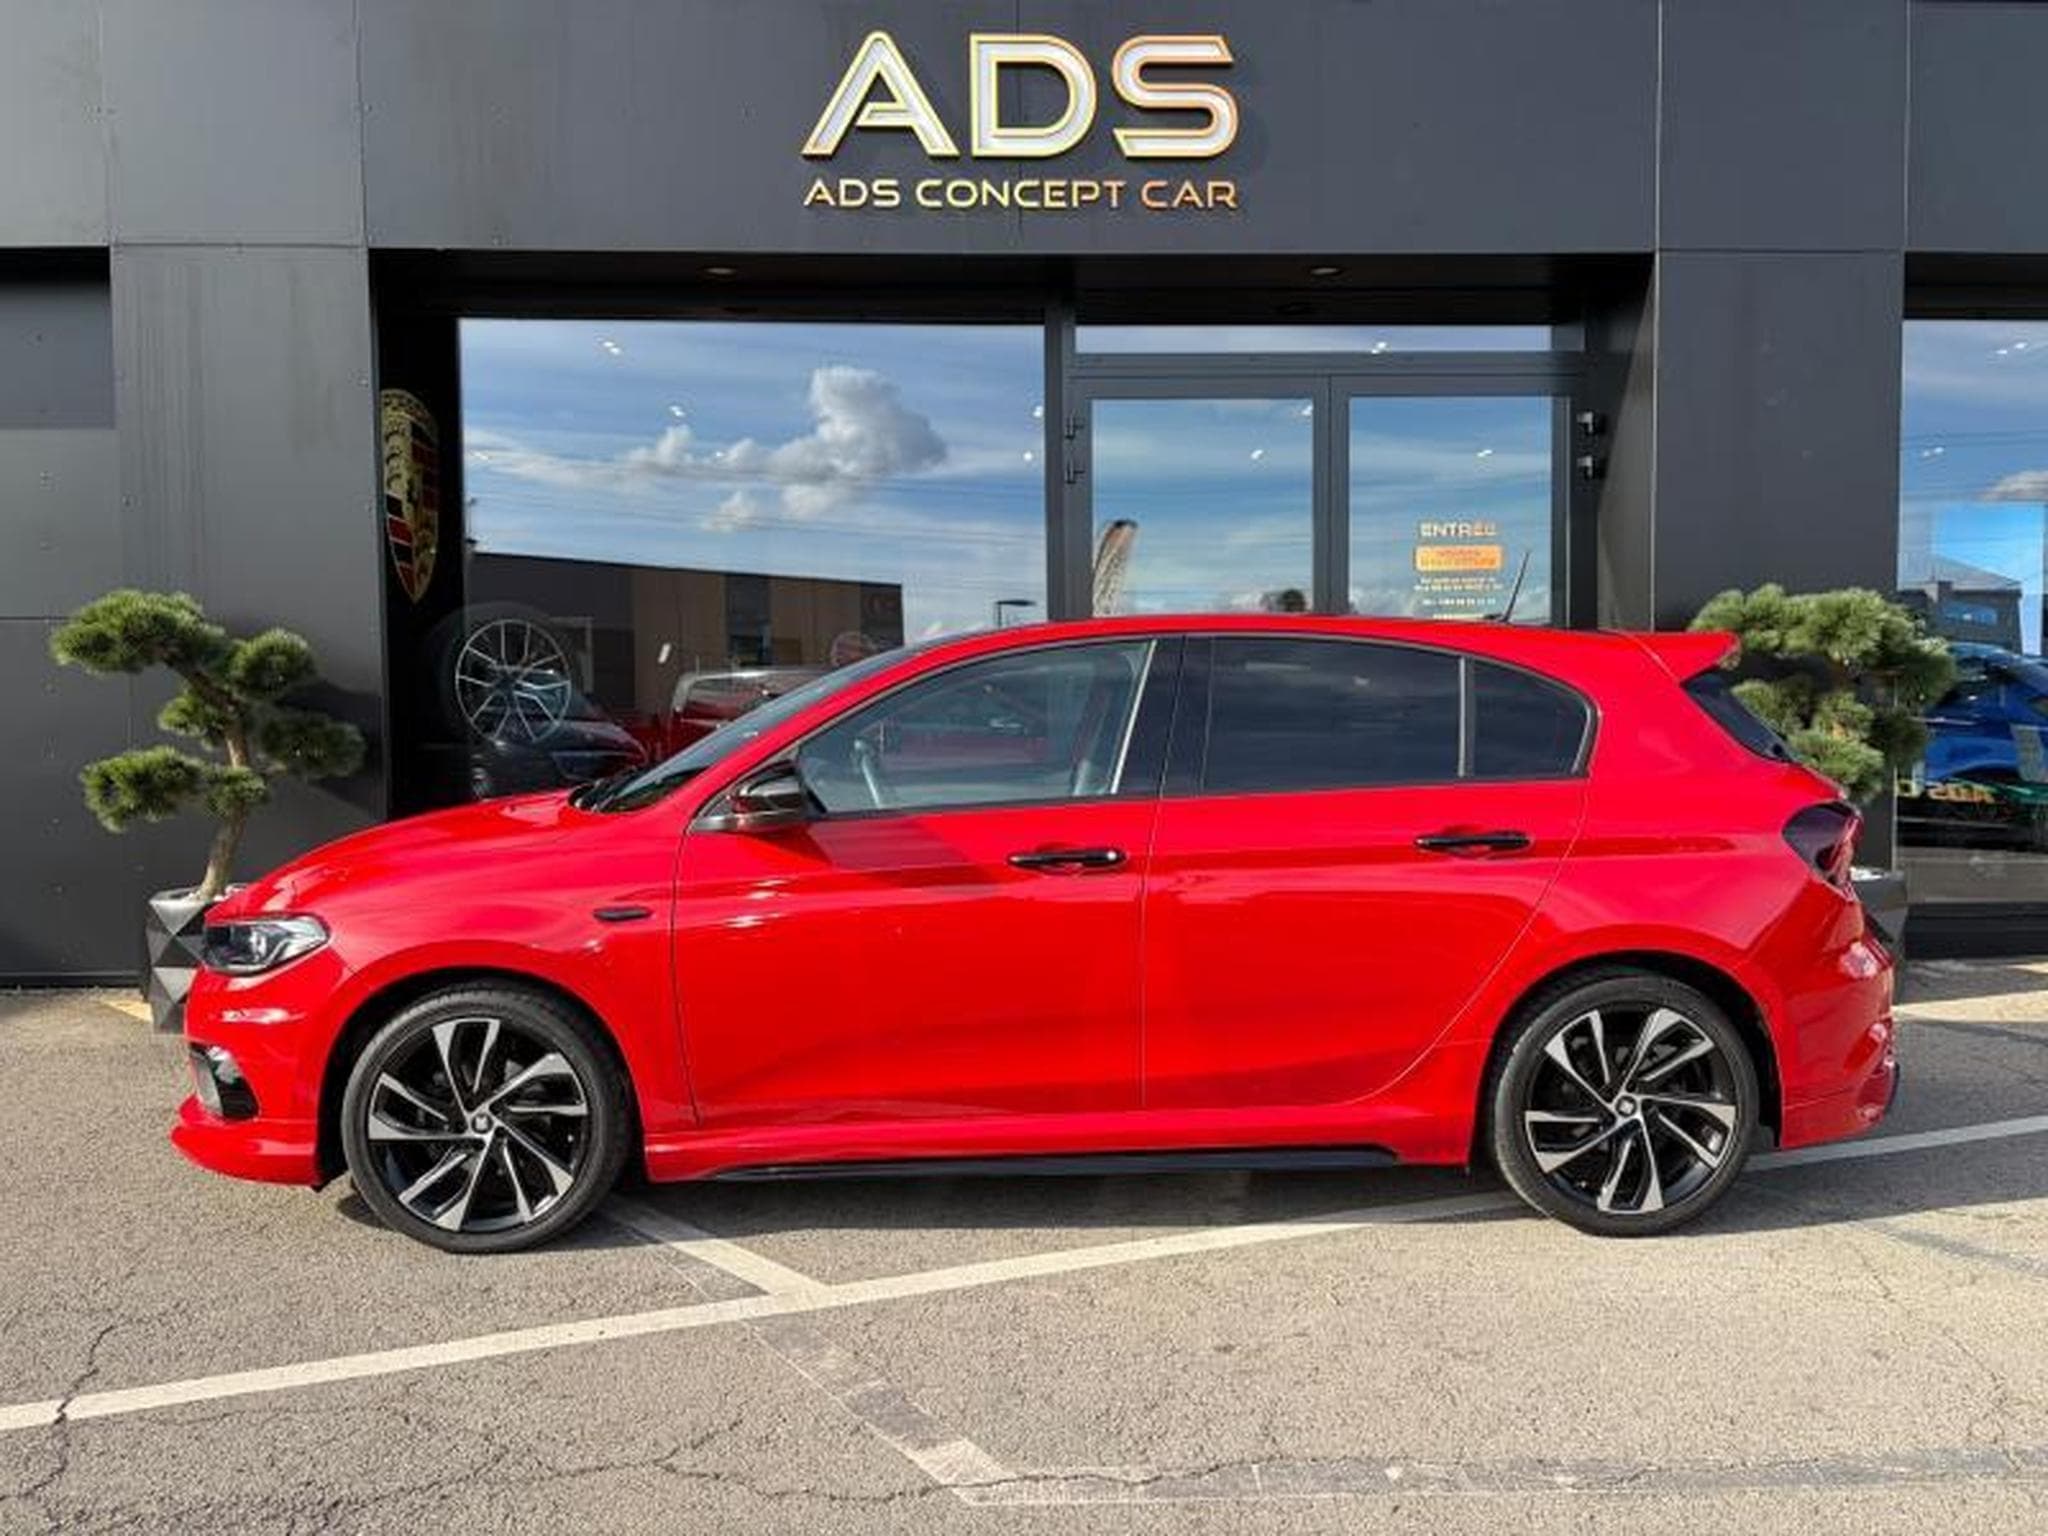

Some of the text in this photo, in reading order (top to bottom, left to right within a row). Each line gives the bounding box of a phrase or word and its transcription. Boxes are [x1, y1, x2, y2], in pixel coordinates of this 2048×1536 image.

[801, 31, 1239, 158] ADS
[803, 178, 1239, 209] ADS CONCEPT CAR
